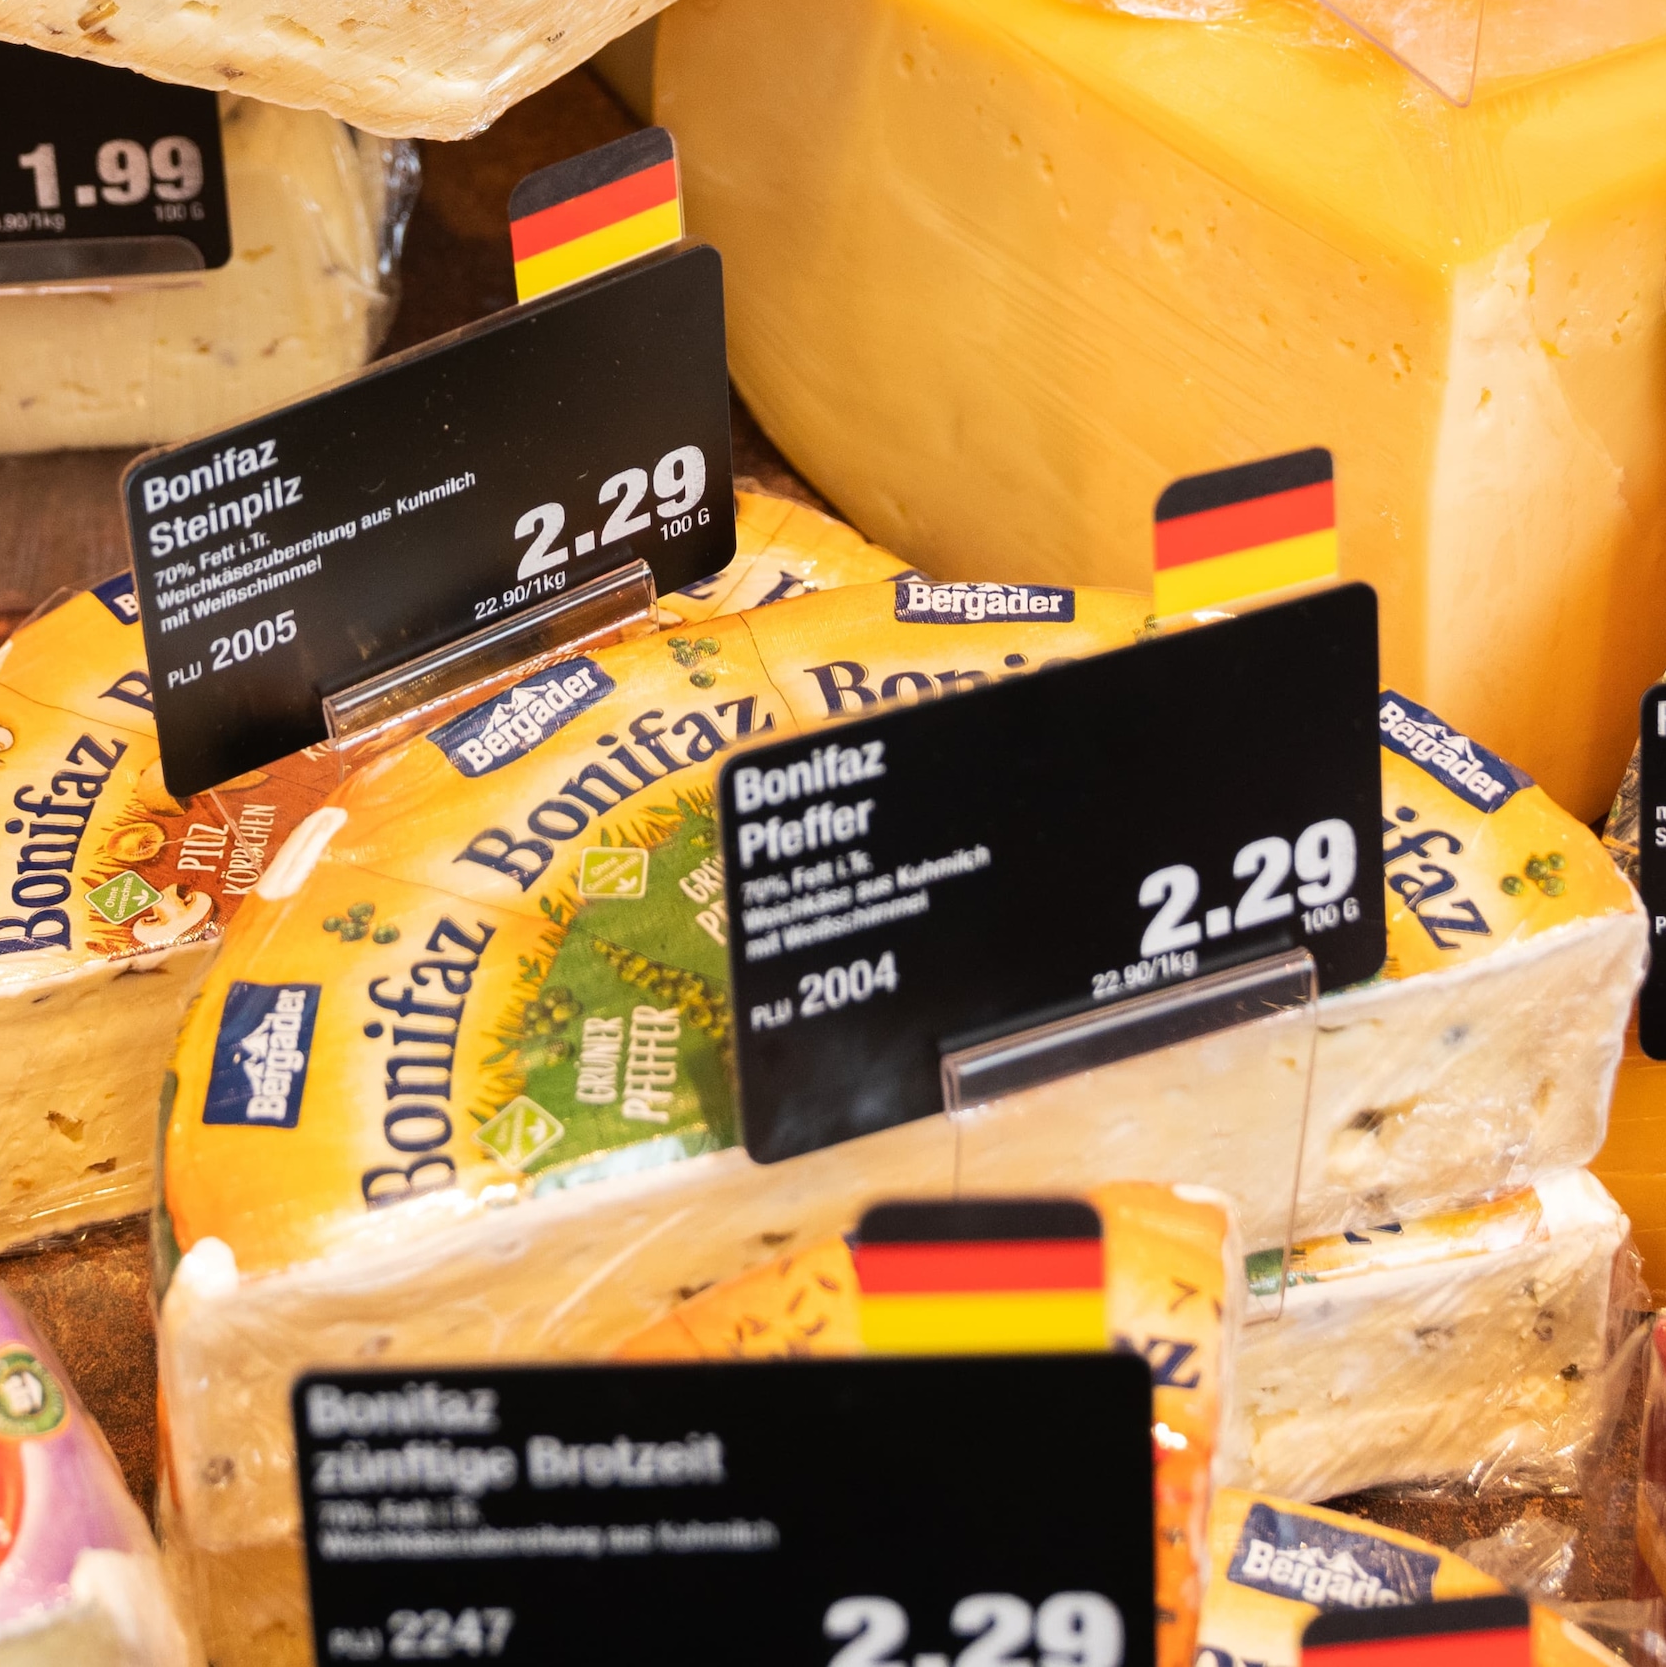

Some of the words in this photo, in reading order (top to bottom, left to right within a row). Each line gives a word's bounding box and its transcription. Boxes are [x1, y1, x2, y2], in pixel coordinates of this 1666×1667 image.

[19, 138, 202, 208] 1.99
[144, 440, 278, 513] Bonifaz
[515, 446, 709, 581] 2.29
[150, 477, 302, 557] Steinpilz
[156, 521, 356, 610] Weichkäsezubereitung
[361, 508, 391, 529] aus
[397, 472, 475, 514] Kuhmilch
[161, 608, 190, 632] mit
[193, 555, 321, 618] Weißschimmel
[475, 571, 565, 620] 22.90/1kg
[907, 585, 1063, 619] Bergader
[210, 610, 297, 671] 2005
[457, 666, 599, 774] Bergader
[1379, 701, 1505, 801] Bergader
[452, 693, 774, 892] Bonifaz
[735, 741, 883, 812] Bonifaz
[176, 822, 229, 873] PILZ
[739, 800, 872, 865] Pfeffer
[1139, 819, 1356, 958] 2.29
[800, 952, 897, 1016] 2004
[248, 987, 307, 1120] Bergader
[361, 915, 497, 1211] Bonifaz
[574, 1017, 623, 1106] GRÜNER
[621, 1005, 680, 1124] PFEFFER
